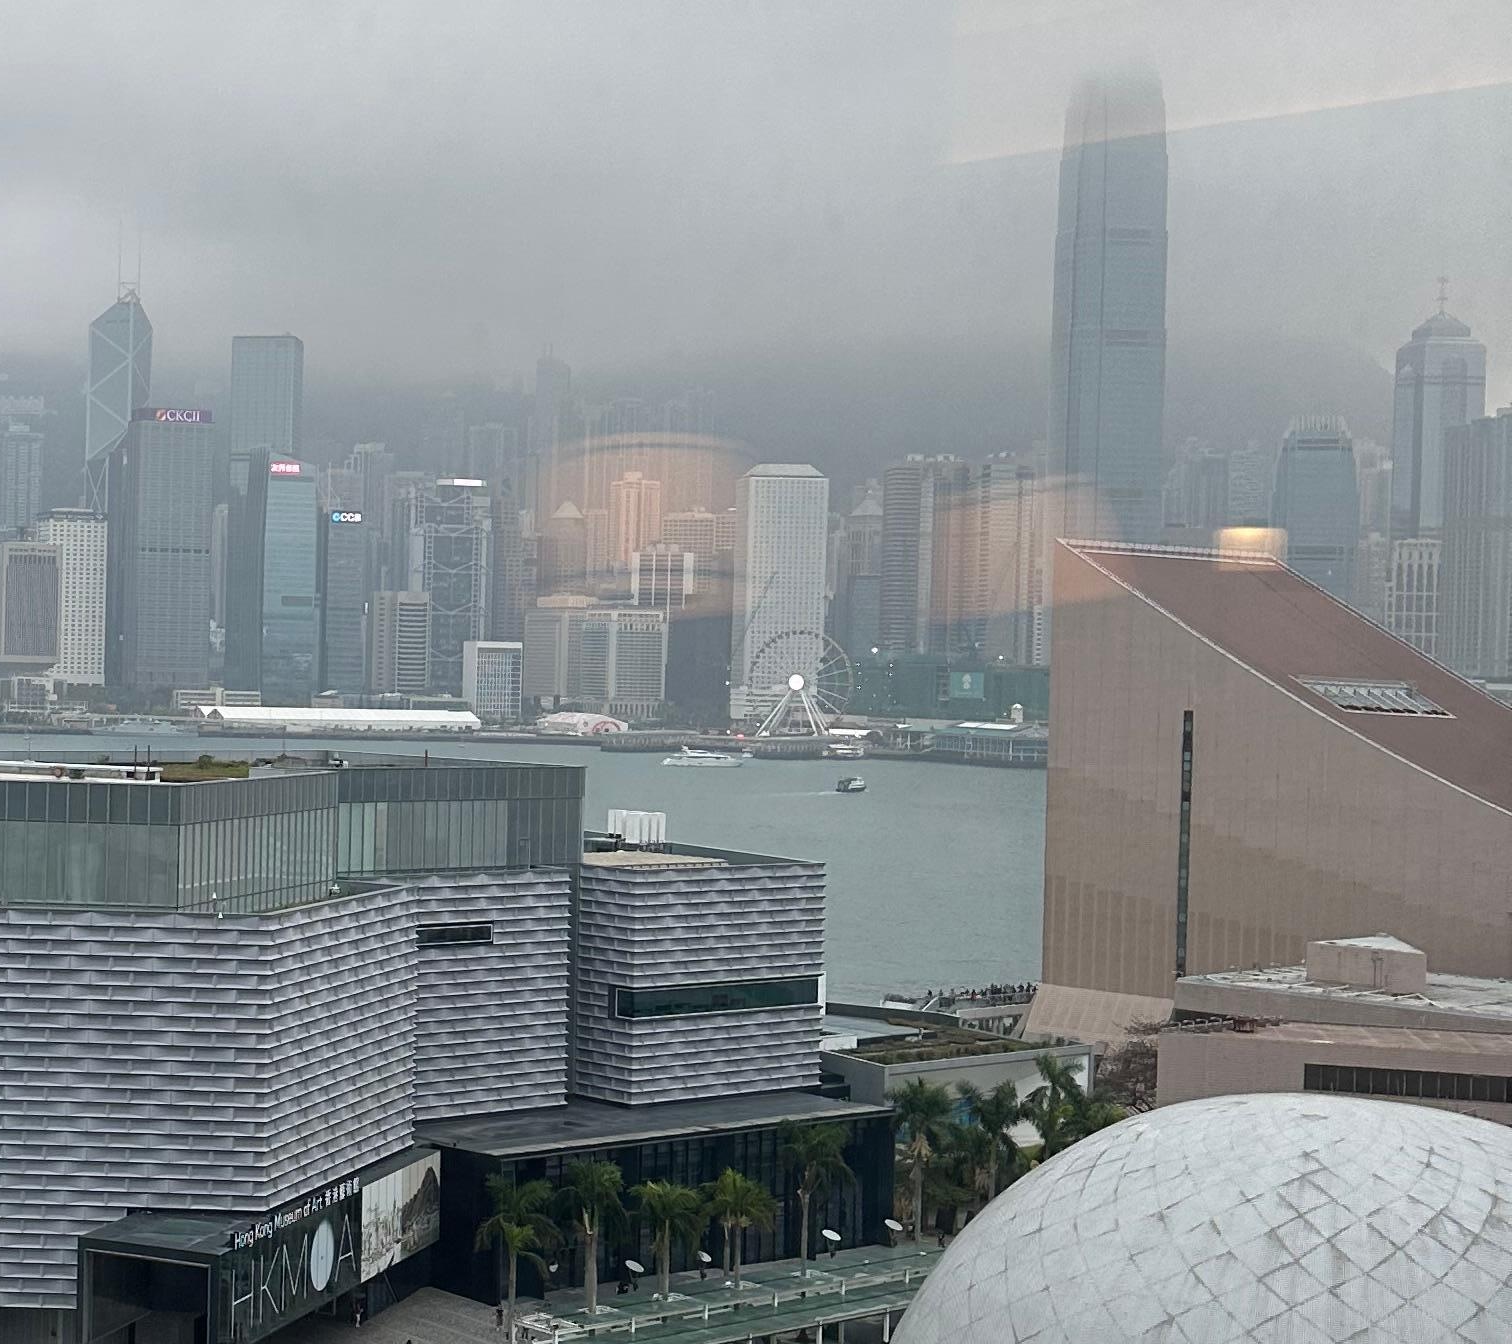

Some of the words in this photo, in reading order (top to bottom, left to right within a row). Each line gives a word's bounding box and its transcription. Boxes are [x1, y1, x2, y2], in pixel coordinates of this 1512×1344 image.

[234, 1229, 254, 1251] Hong
[255, 1220, 273, 1240] Kong
[274, 1207, 302, 1231] Museum
[303, 1197, 311, 1217] of
[312, 1196, 323, 1212] Art
